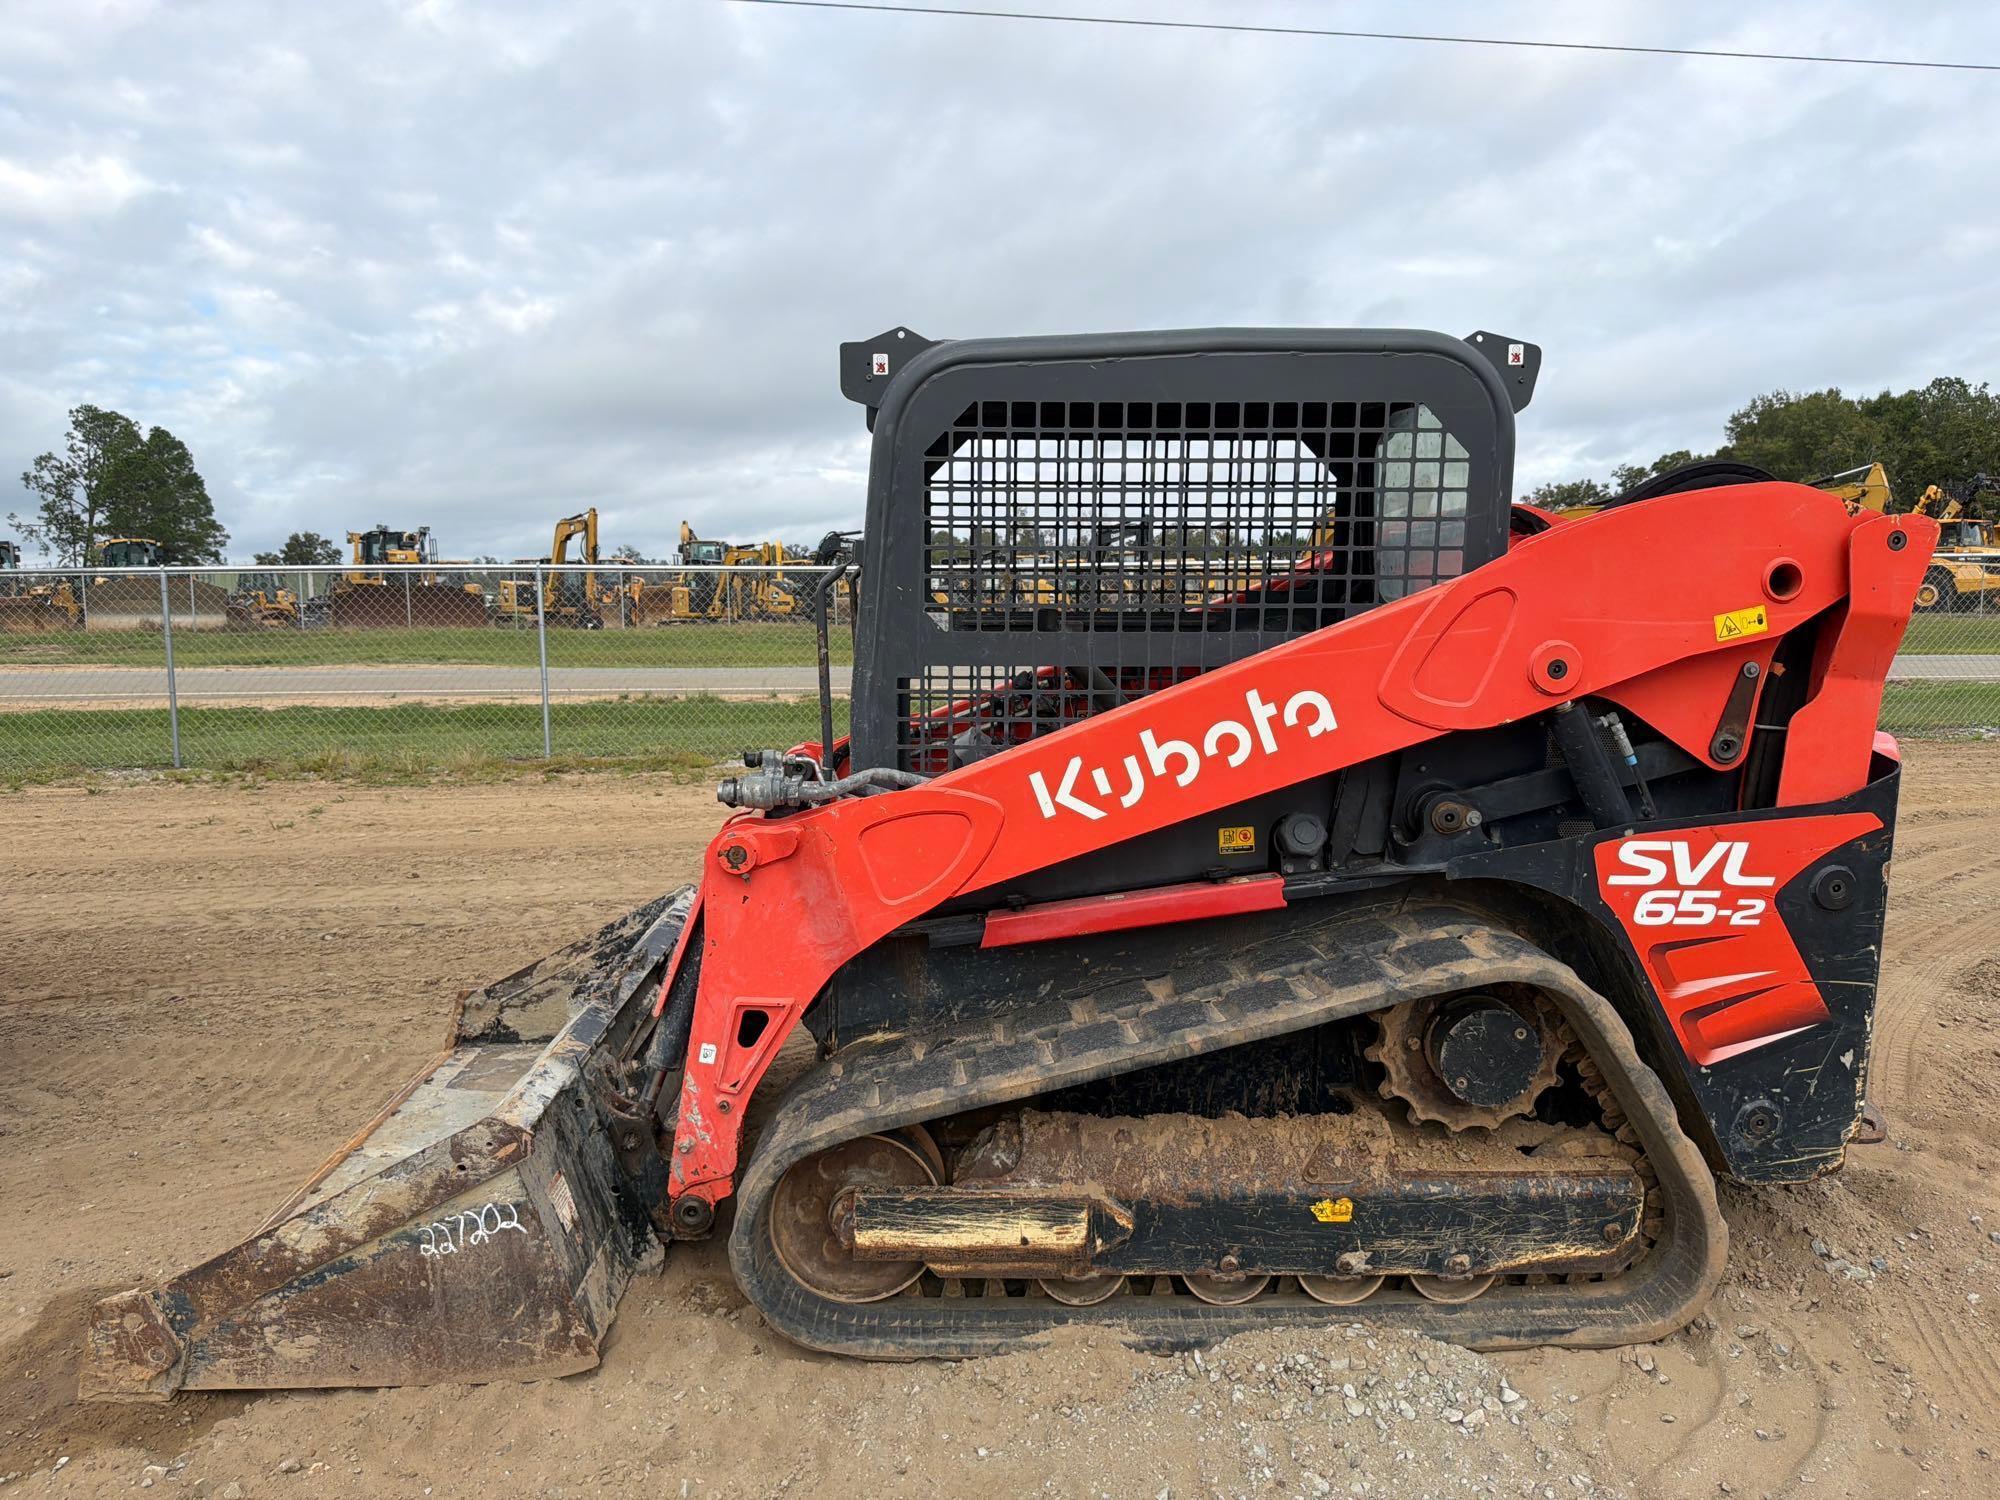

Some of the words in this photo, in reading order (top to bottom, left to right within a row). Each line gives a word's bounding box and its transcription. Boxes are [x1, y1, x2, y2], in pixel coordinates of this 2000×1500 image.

[1028, 688, 1338, 820] Kubota
[1607, 840, 1776, 887] SVL
[1633, 889, 1766, 926] 65-2
[417, 1202, 528, 1259] 227202
